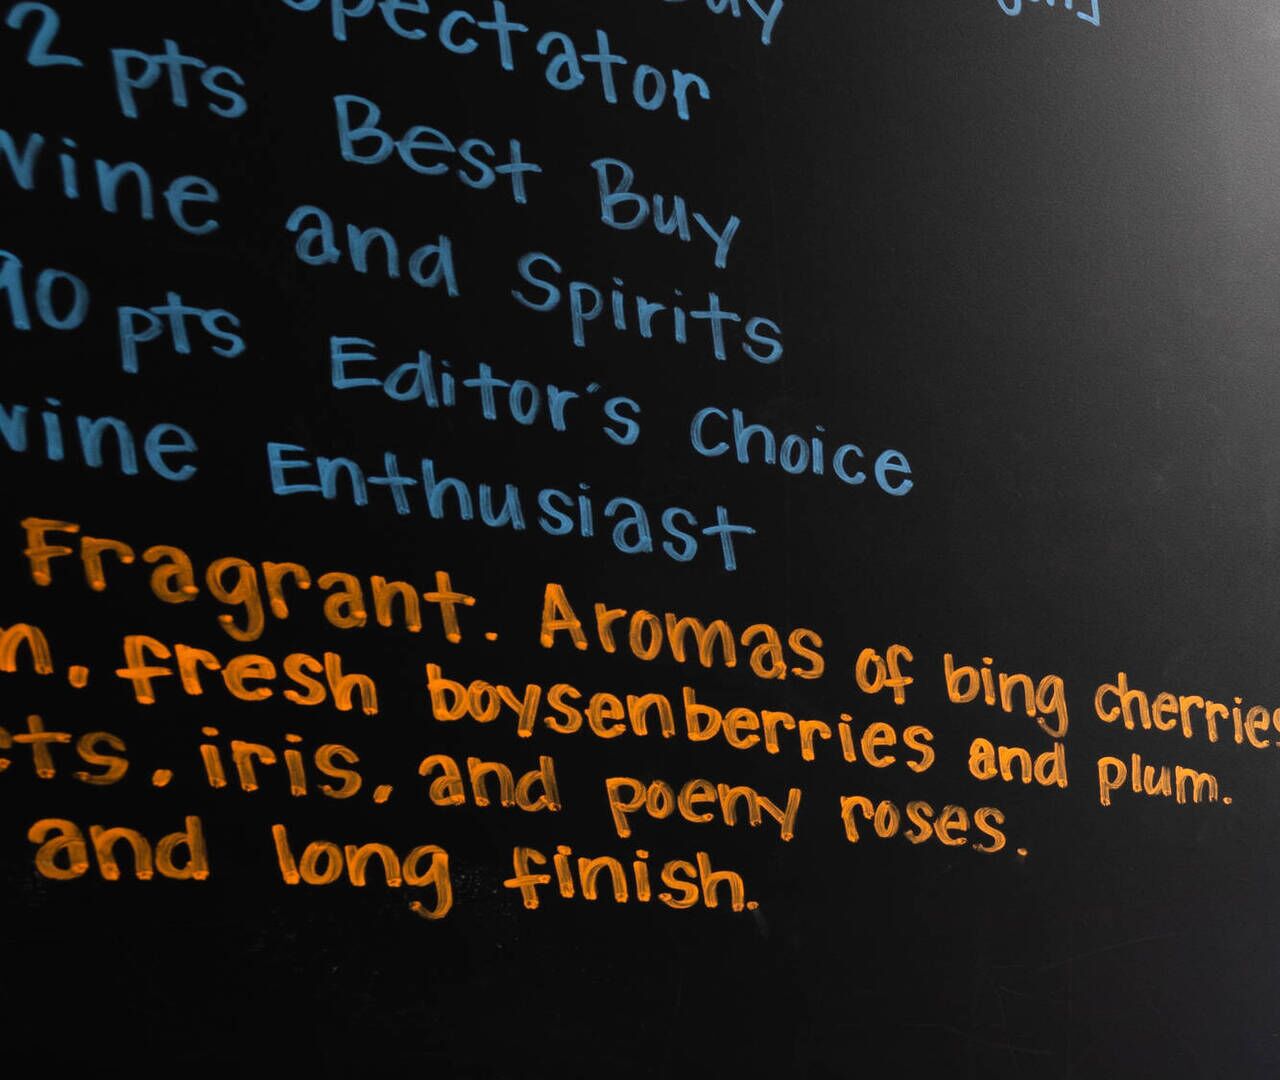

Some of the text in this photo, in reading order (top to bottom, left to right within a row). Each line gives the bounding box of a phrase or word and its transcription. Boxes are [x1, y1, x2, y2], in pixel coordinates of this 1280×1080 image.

[111, 39, 741, 268] pts Best Buy
[286, 205, 785, 365] and Spirits
[118, 291, 642, 447] pts Editor's
[267, 441, 756, 570] Enthusiast
[20, 516, 498, 642] Fragrant.
[539, 584, 824, 684] Aromas
[855, 644, 916, 709] of
[945, 652, 1070, 737] bing
[116, 634, 379, 717] fresh
[425, 663, 936, 774] boysenberries
[968, 718, 1068, 790] and
[1097, 752, 1234, 806] plum.
[201, 727, 393, 803] iris,
[418, 754, 561, 813] and
[606, 775, 802, 841] poeny
[842, 793, 1030, 858] roses.
[28, 815, 761, 919] and long finish.
